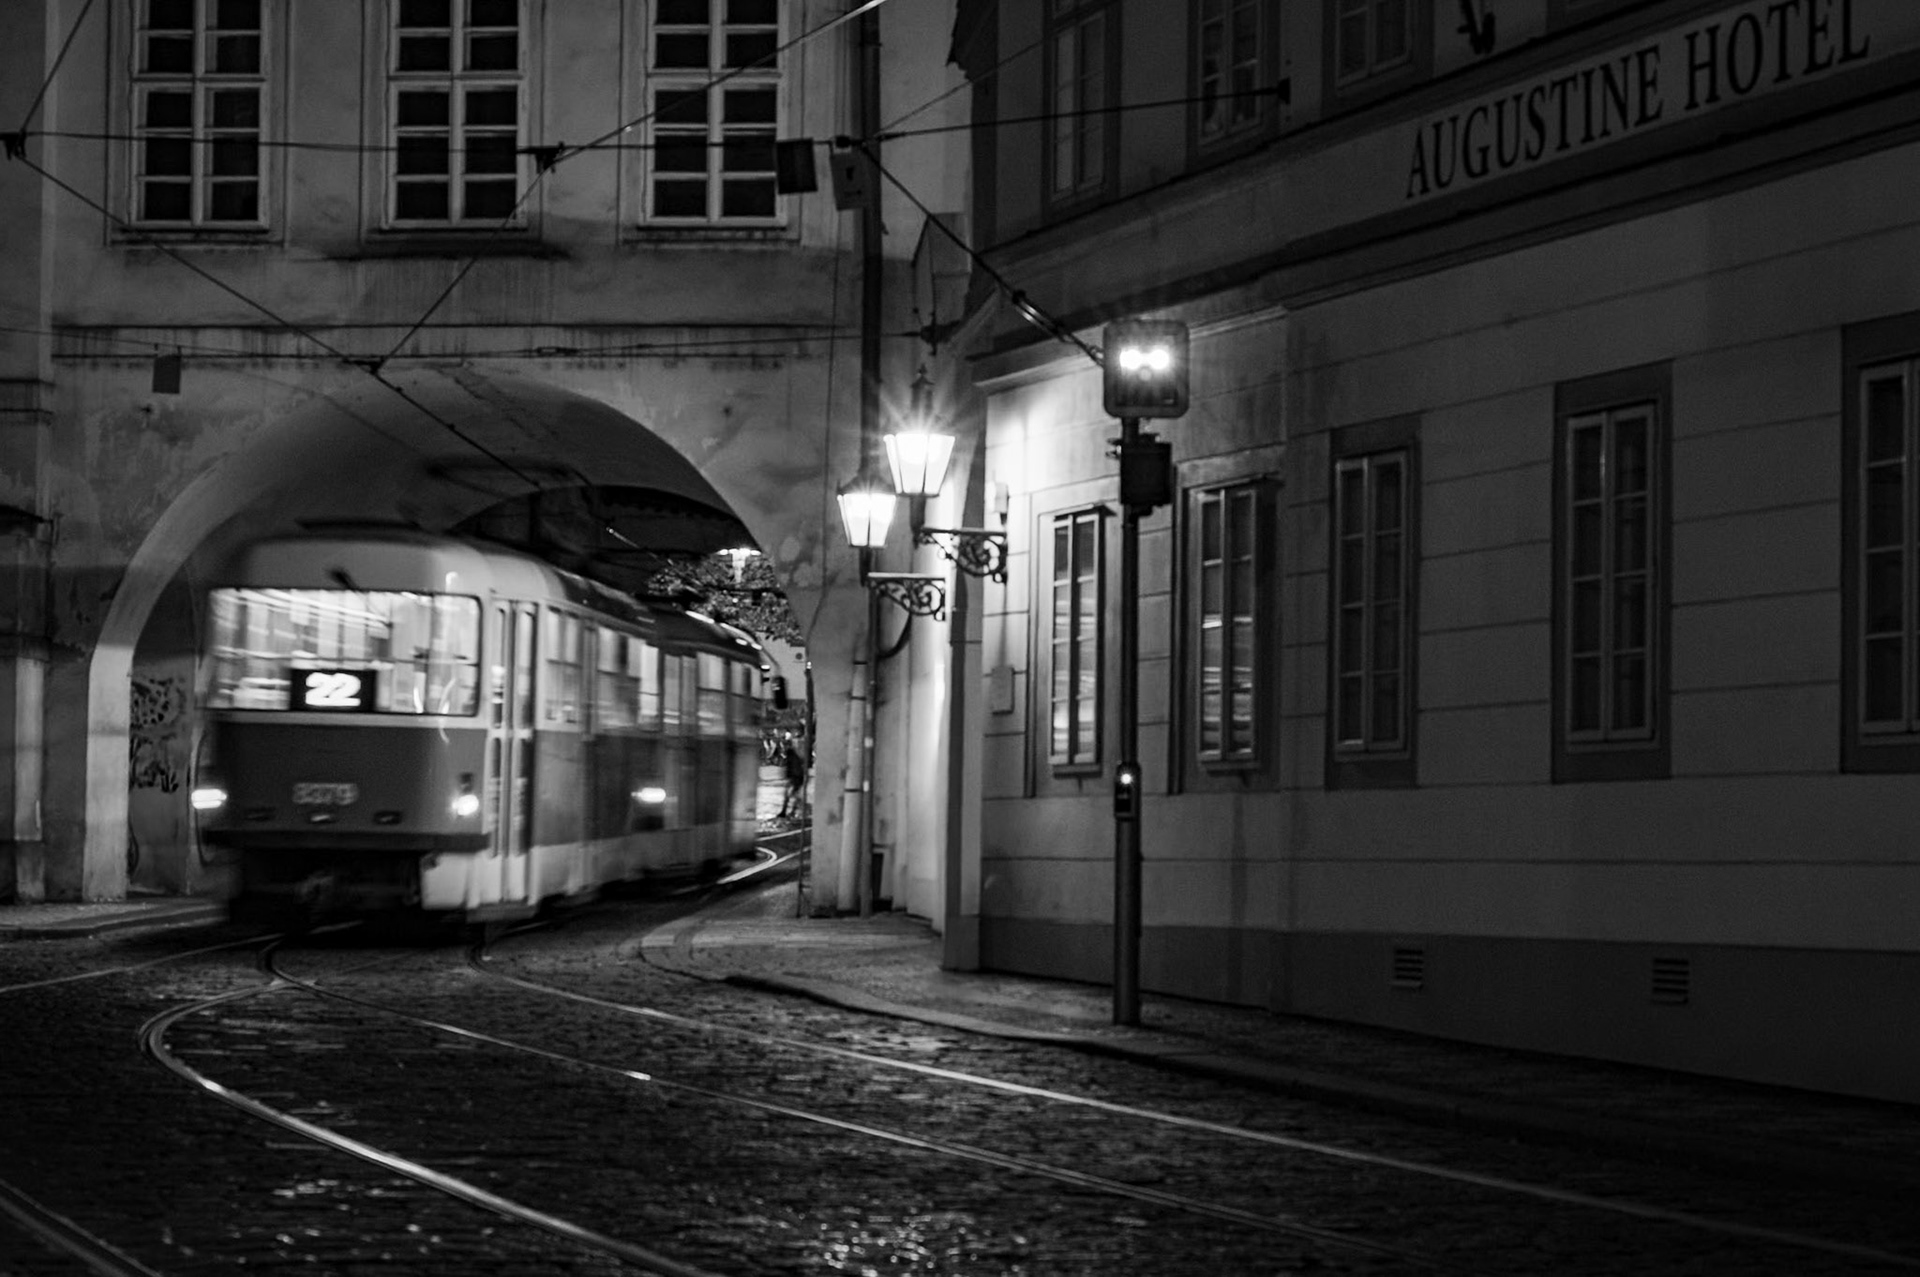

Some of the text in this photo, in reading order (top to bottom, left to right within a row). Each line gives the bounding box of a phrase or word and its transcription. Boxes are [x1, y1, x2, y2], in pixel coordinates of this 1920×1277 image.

[1406, 0, 1870, 198] AUGUSTINE HOTEL
[305, 672, 361, 707] 22
